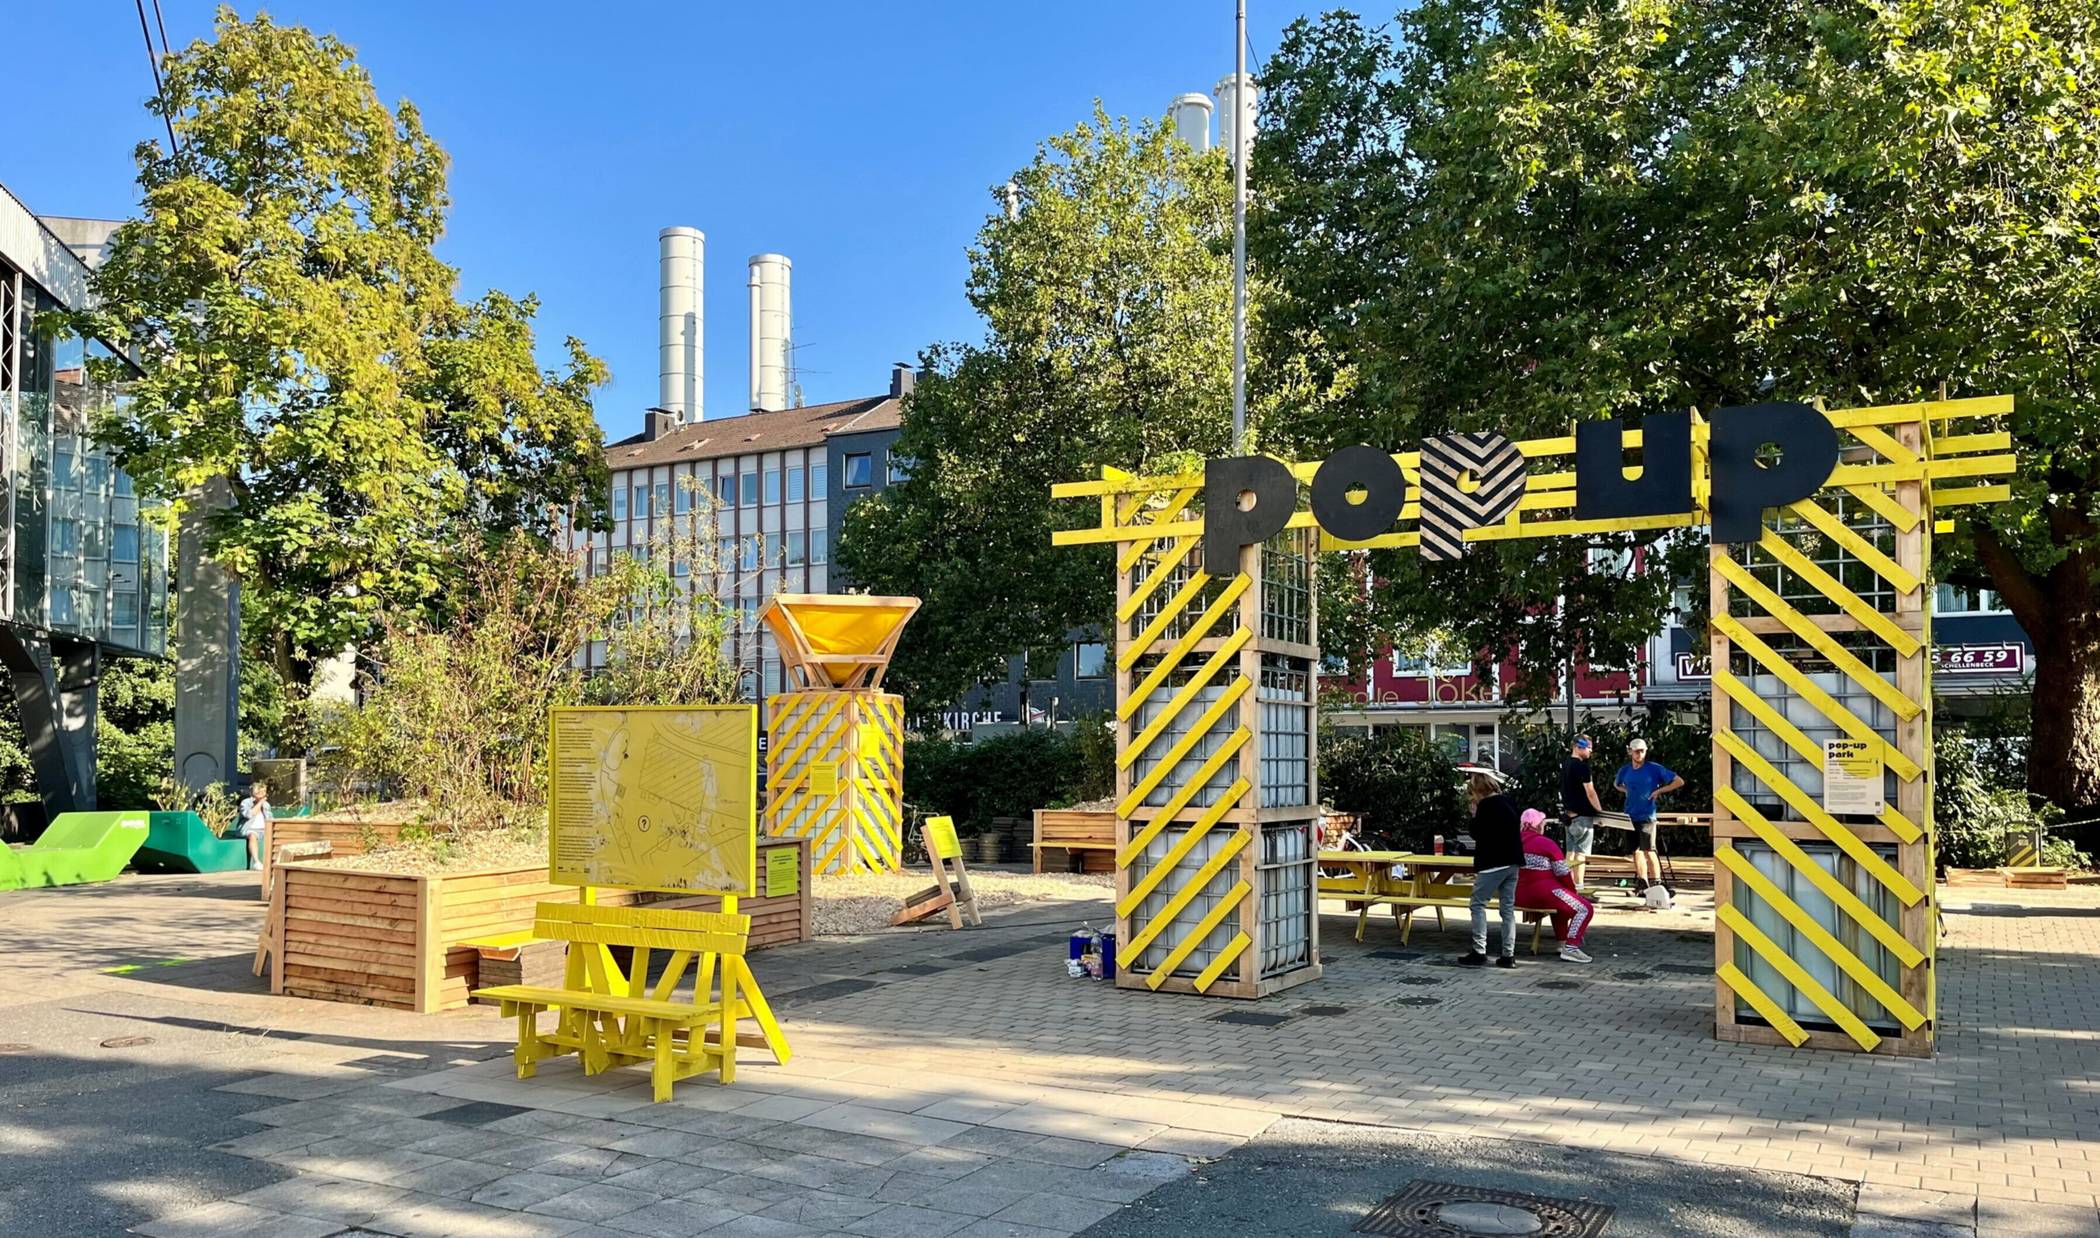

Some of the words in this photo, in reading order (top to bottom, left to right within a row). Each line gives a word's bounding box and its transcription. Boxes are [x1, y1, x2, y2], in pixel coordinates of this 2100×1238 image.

[1950, 651, 1975, 663] 66
[1983, 650, 2008, 662] 59
[1828, 742, 1867, 750] pop-up
[1828, 751, 1854, 759] park
